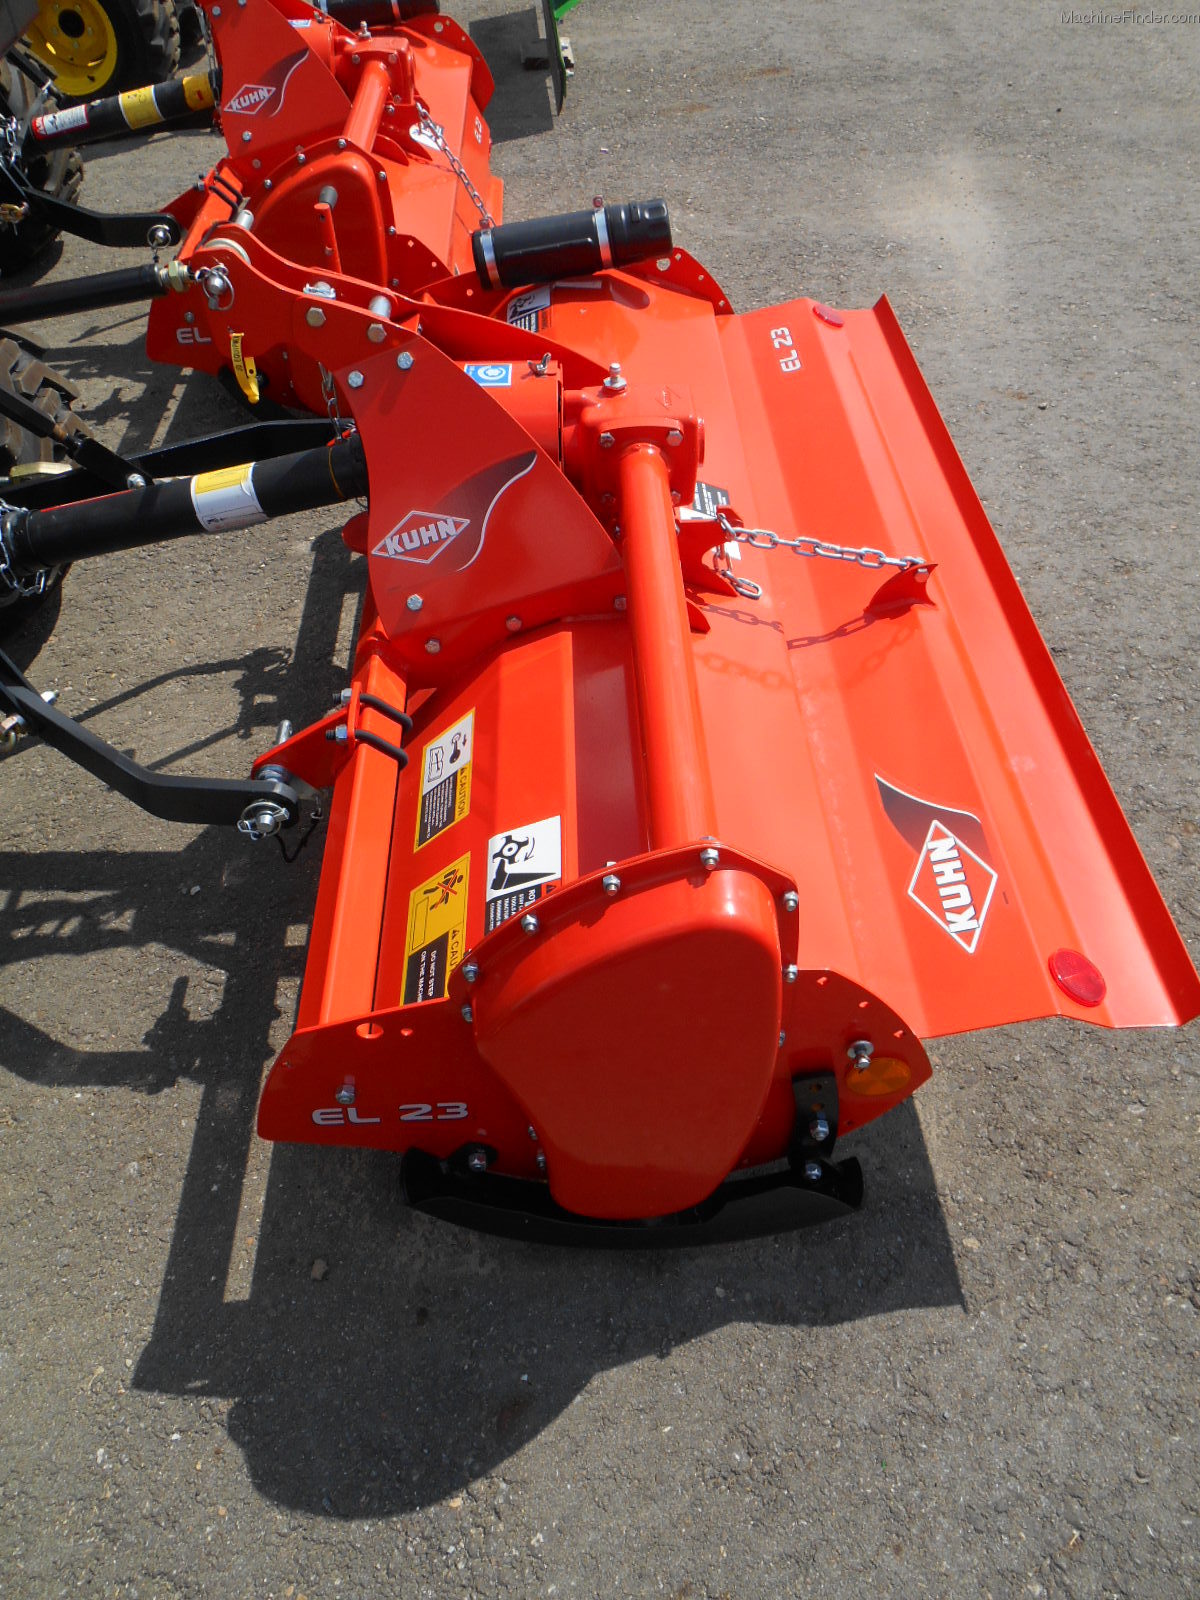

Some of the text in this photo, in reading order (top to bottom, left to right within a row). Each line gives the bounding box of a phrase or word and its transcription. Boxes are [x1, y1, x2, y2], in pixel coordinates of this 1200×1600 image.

[230, 87, 270, 112] KUHN
[176, 327, 212, 344] EL
[770, 327, 802, 372] EL 23
[385, 518, 458, 557] KUHN
[457, 775, 469, 817] CAUTION
[927, 836, 981, 934] KUHN
[420, 950, 427, 963] ON
[430, 950, 437, 962] DO
[449, 940, 460, 968] CAU
[311, 1102, 469, 1125] EL 23
